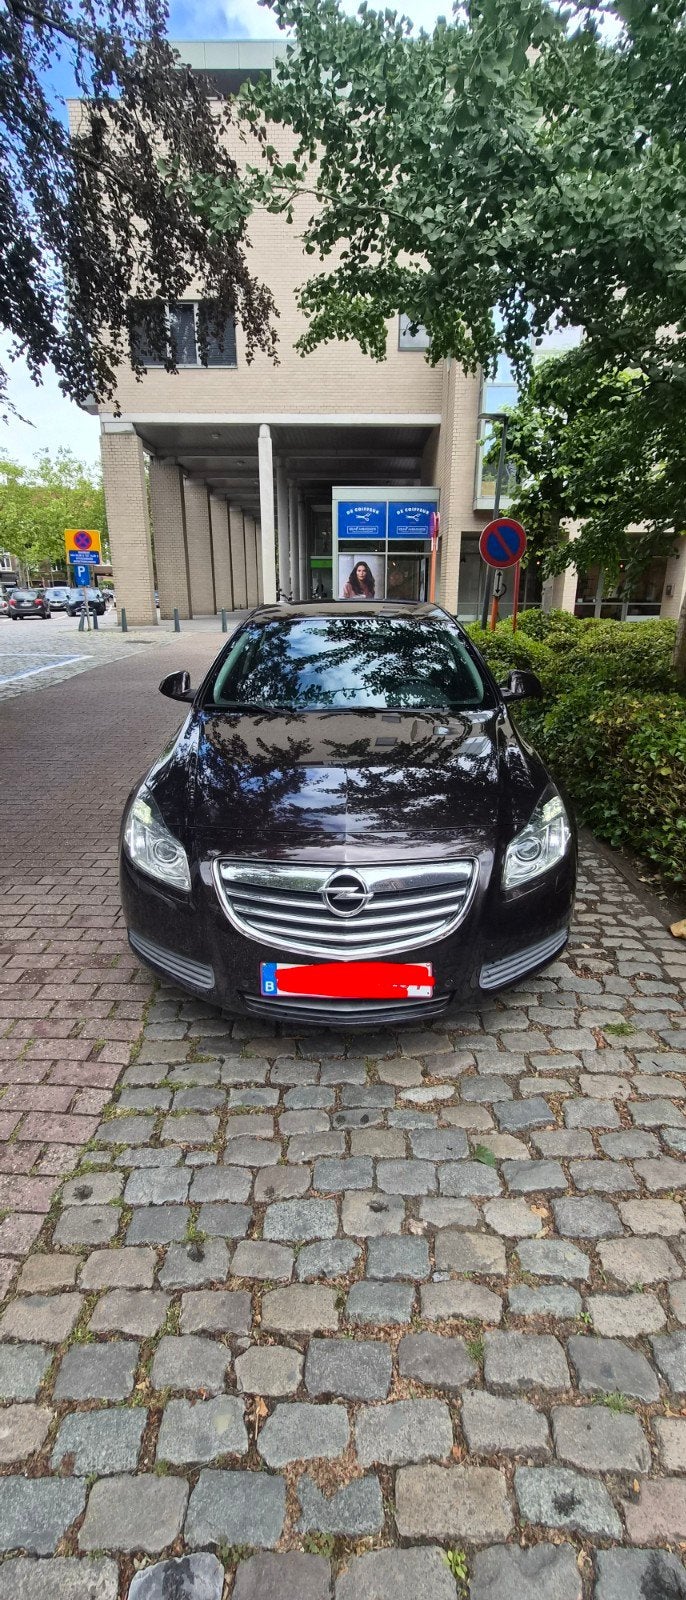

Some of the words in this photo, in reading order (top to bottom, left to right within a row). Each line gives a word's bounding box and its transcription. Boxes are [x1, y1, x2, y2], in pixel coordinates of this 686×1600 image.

[354, 507, 380, 515] COIFFEUR
[405, 507, 430, 515] COIFFEUR
[77, 566, 85, 577] P
[265, 981, 274, 992] B
